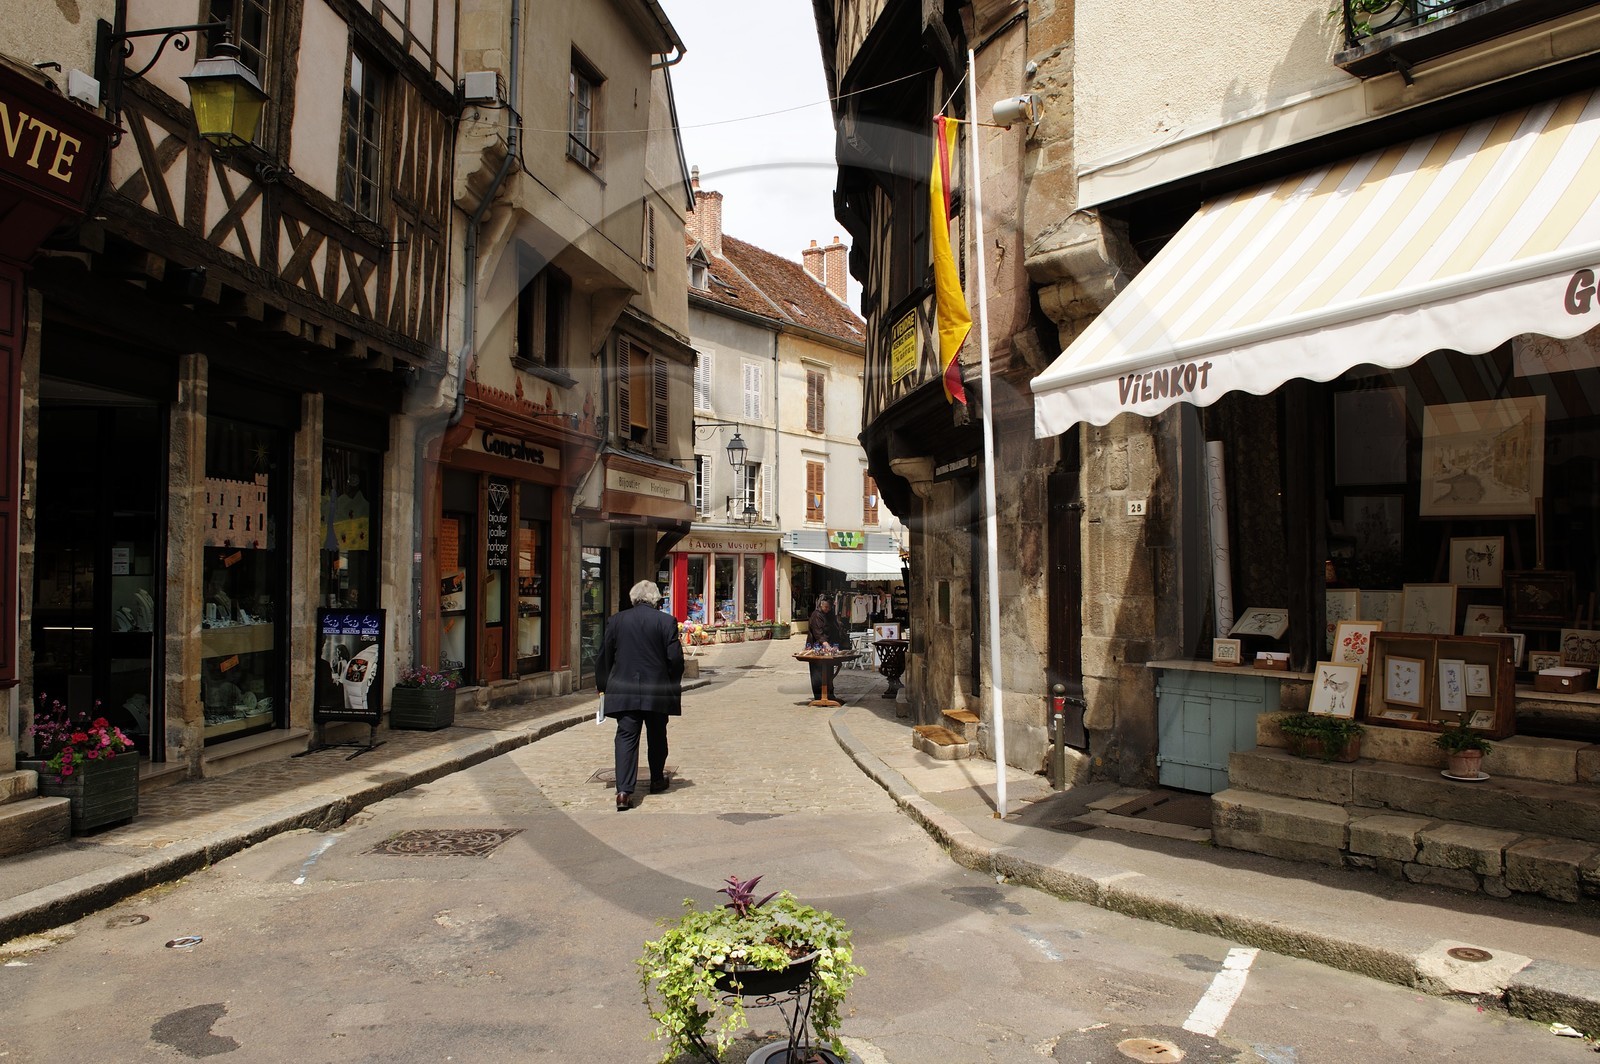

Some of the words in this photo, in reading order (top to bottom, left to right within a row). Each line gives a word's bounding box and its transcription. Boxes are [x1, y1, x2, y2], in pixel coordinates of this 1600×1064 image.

[1564, 268, 1600, 316] G
[897, 312, 915, 338] VENDRE
[482, 430, 545, 464] Gonçalves
[618, 476, 641, 490] Bijoutier
[650, 482, 671, 498] Horloger
[1130, 503, 1143, 513] 28
[488, 509, 508, 525] bijoutier
[487, 539, 509, 554] horloger
[695, 541, 723, 549] AUXOIS
[727, 541, 757, 550] MUSIQUE
[488, 553, 508, 566] orfèvre
